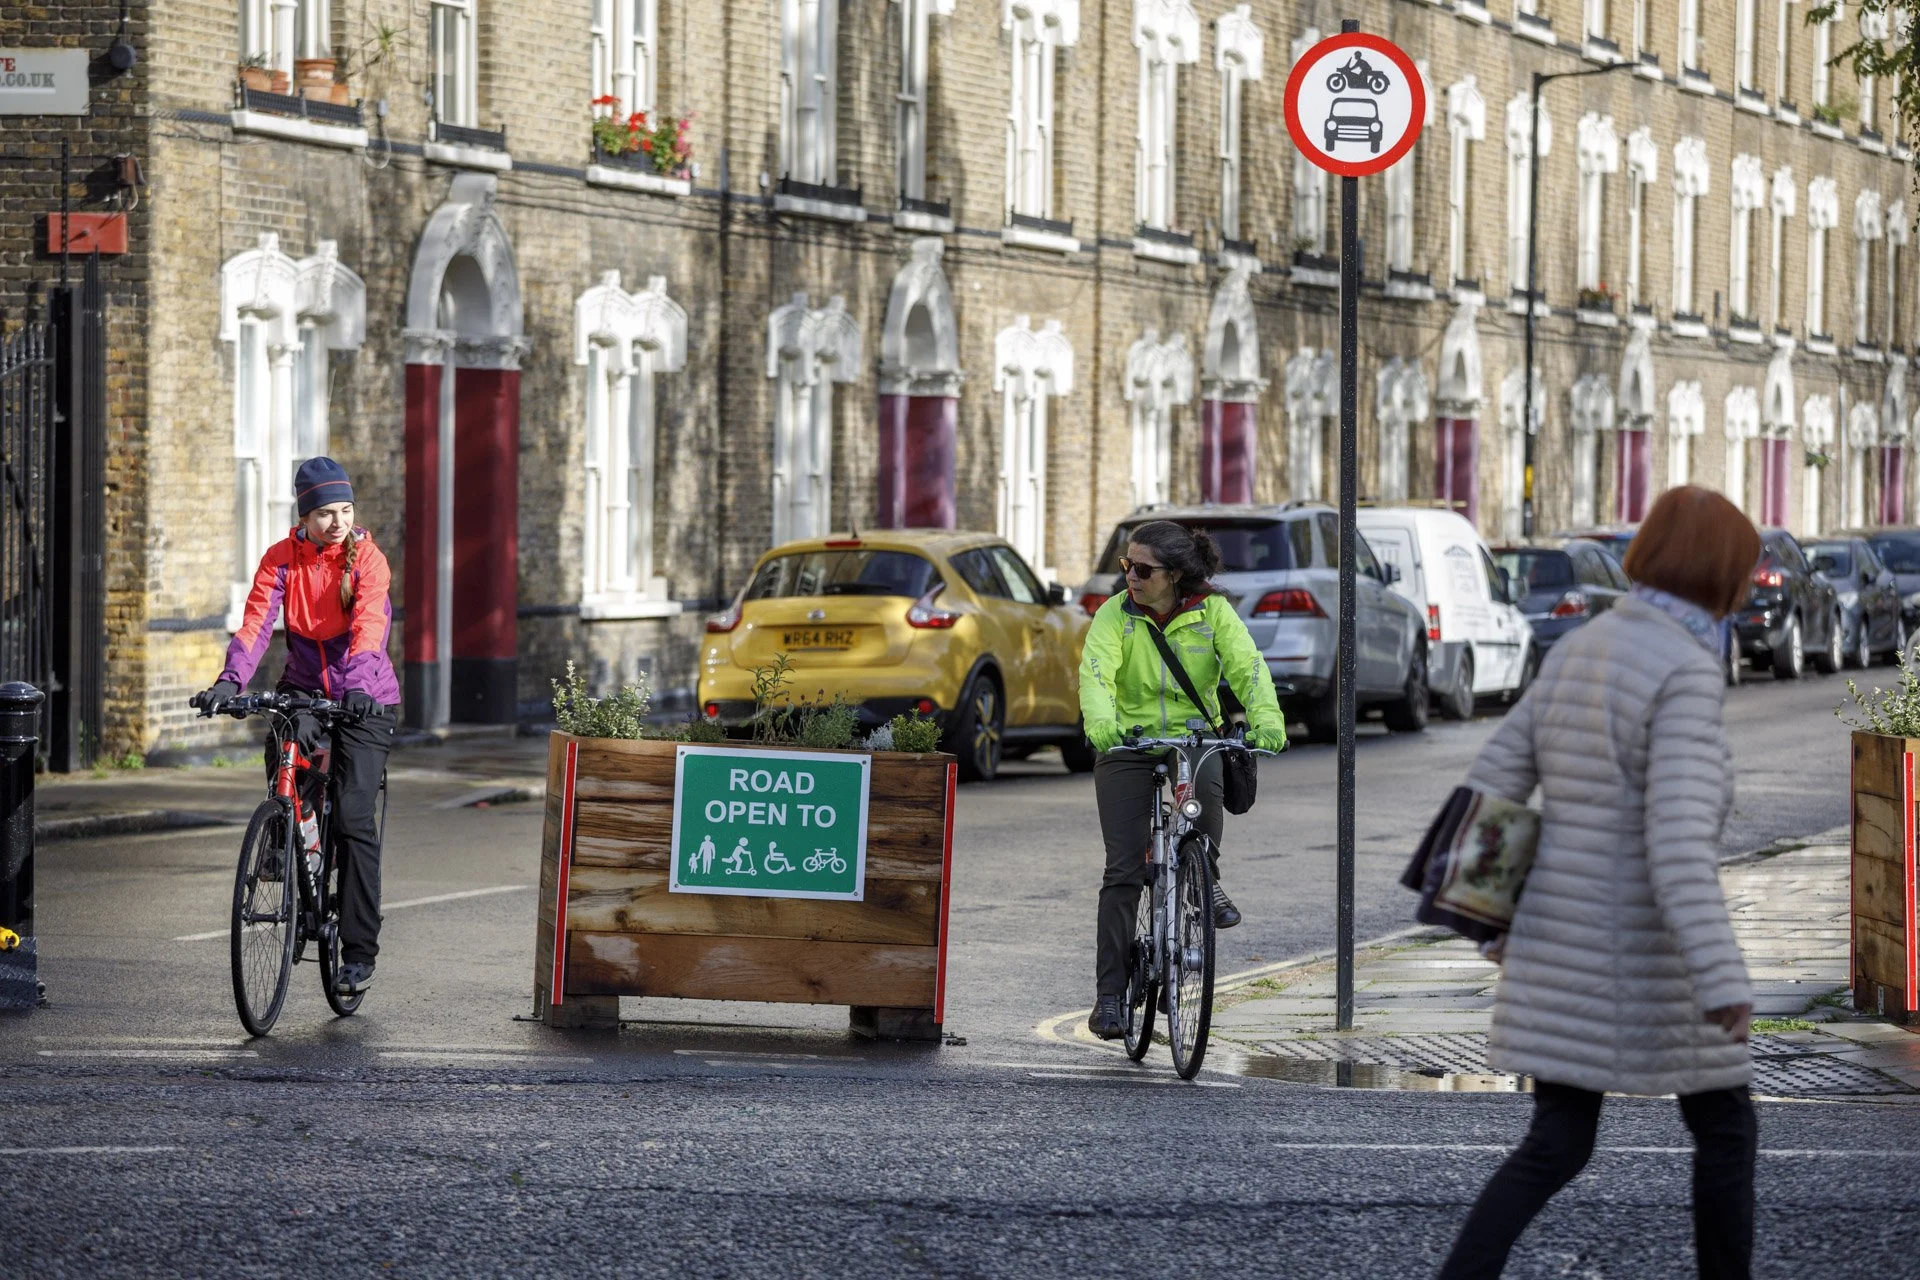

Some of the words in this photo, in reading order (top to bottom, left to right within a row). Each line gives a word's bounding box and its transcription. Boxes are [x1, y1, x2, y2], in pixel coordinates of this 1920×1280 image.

[0, 72, 56, 88] .CO.UK
[783, 631, 820, 646] WR64
[729, 768, 815, 795] ROAD
[704, 800, 787, 826] OPEN
[797, 804, 837, 828] TO
